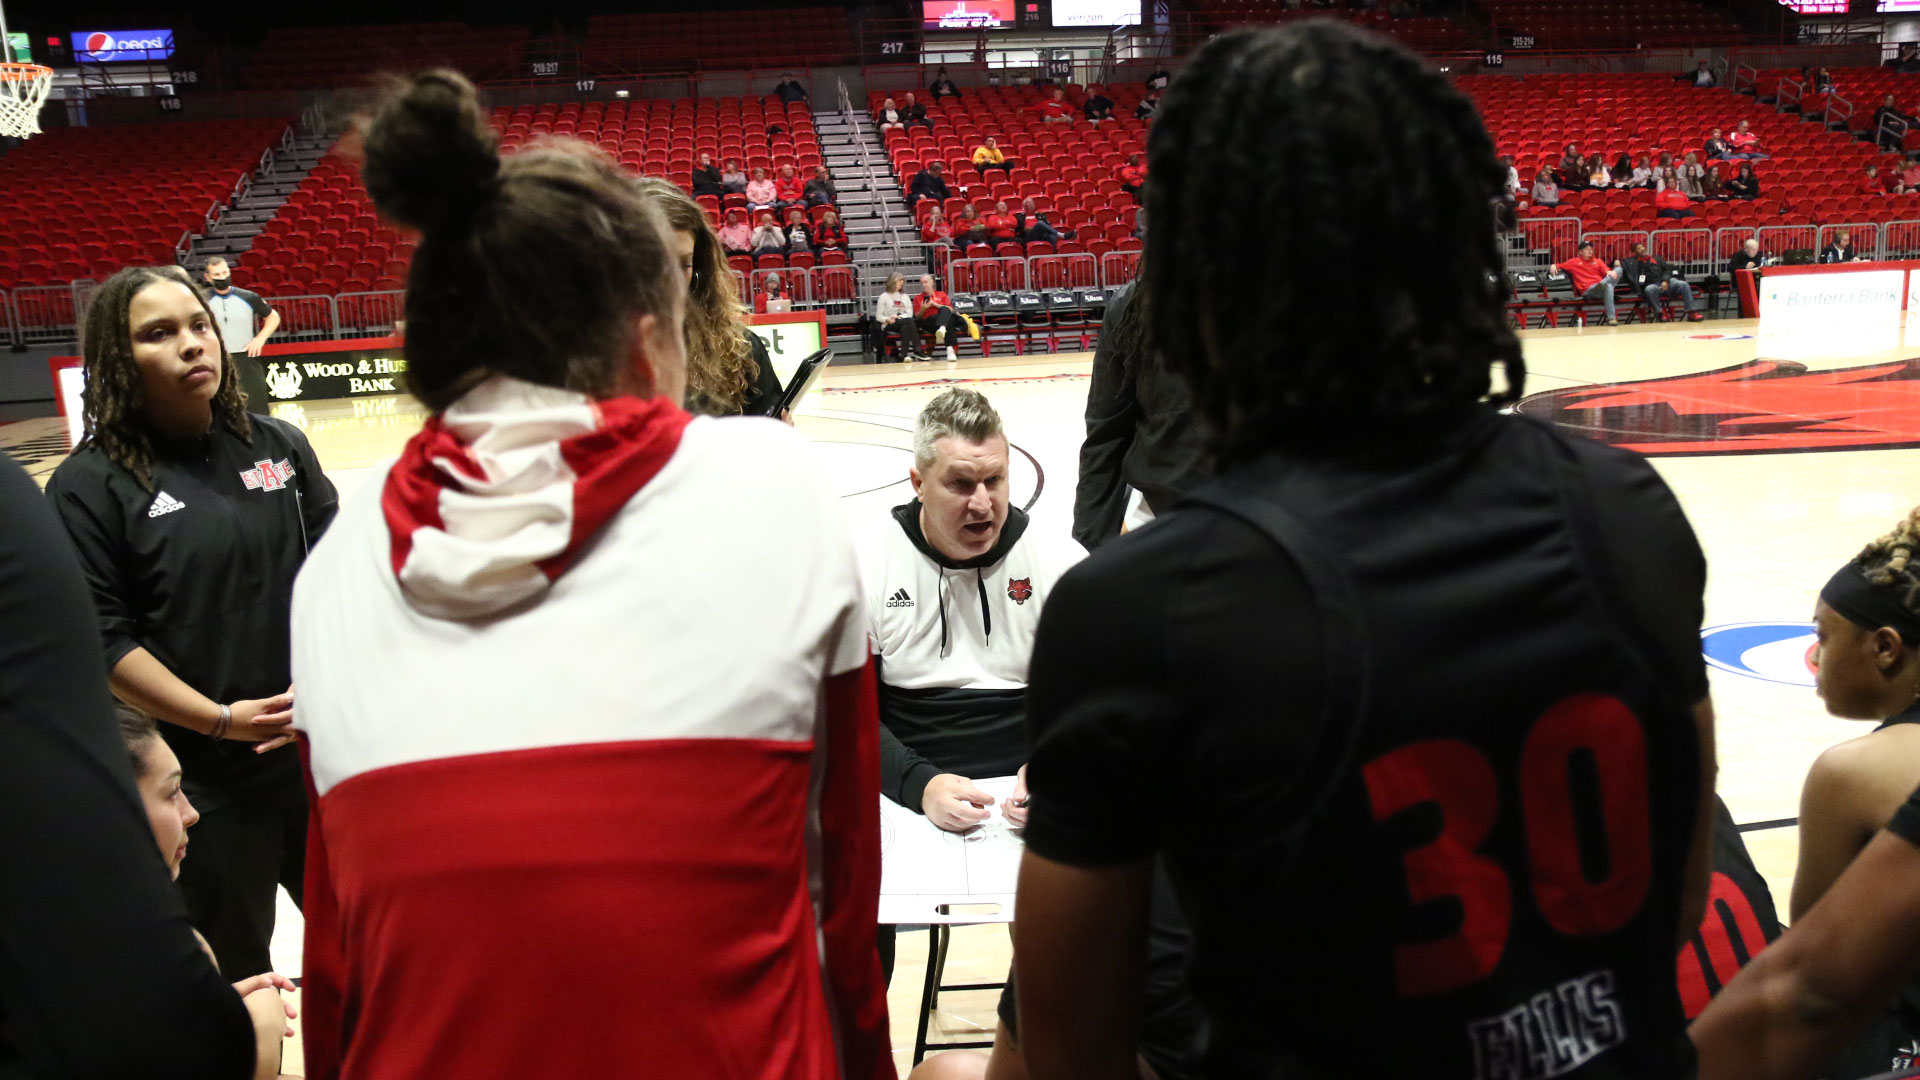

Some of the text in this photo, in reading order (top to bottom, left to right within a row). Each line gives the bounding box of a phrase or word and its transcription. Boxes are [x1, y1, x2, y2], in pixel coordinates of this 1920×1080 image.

[1799, 25, 1816, 35] 214
[117, 37, 162, 54] pepsi
[881, 42, 903, 54] 217
[1486, 54, 1502, 64] 115
[1050, 62, 1069, 73] 116
[172, 71, 197, 82] 218
[575, 80, 595, 91] 117
[159, 98, 181, 109] 118
[1858, 288, 1897, 304] Bank
[302, 362, 354, 378] WOOD
[357, 359, 373, 375] &
[348, 377, 396, 393] BANK
[239, 458, 296, 492] STATE
[148, 501, 186, 518] adidas
[886, 600, 915, 608] adidas
[1362, 690, 1653, 999] 30
